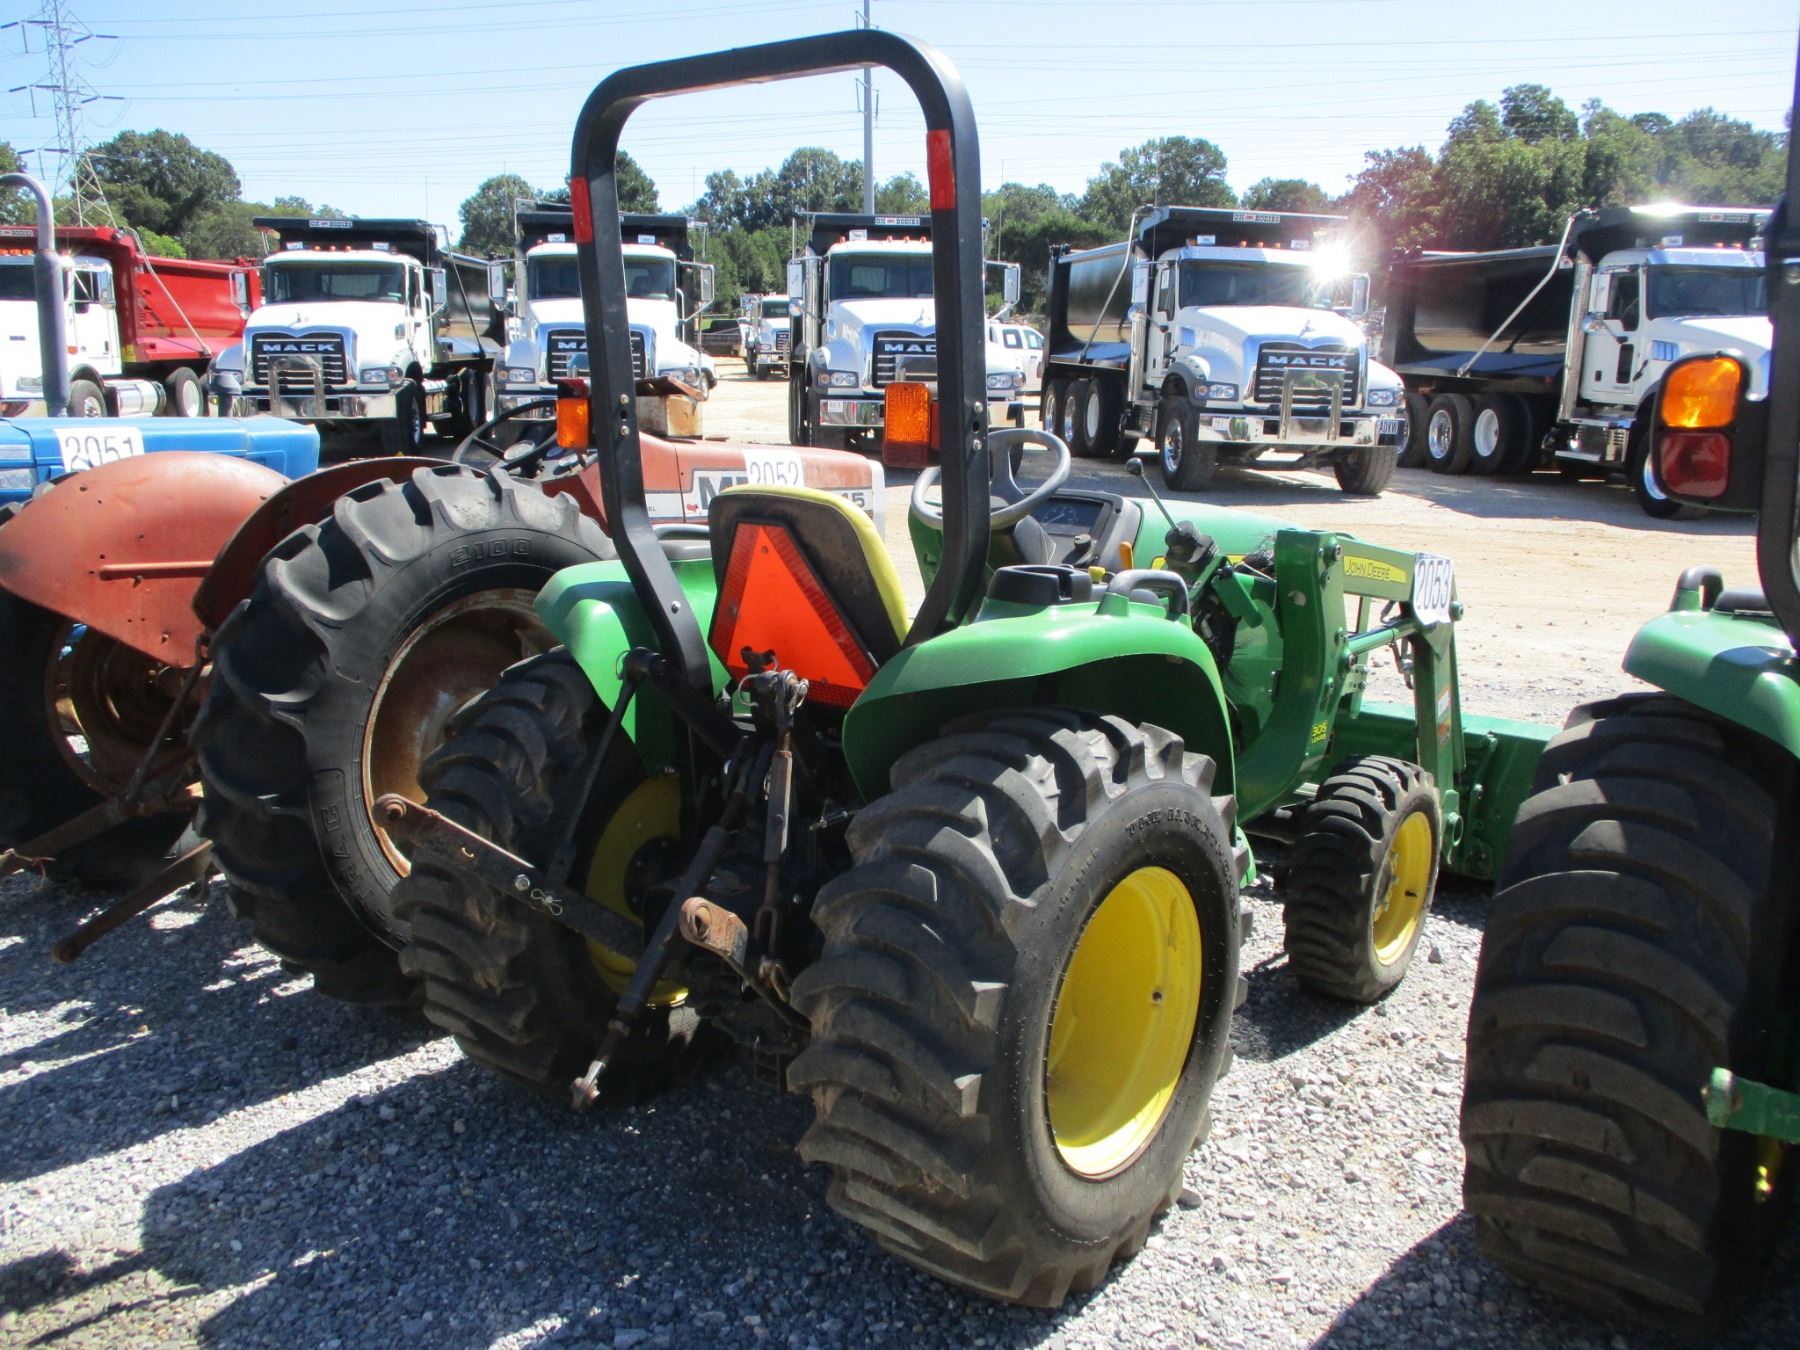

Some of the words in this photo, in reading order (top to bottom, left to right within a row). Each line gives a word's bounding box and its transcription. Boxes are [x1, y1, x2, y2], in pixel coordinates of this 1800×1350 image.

[262, 343, 335, 352] MACK
[884, 343, 937, 352] MAC
[1268, 355, 1347, 366] MACK
[64, 434, 136, 471] 2051
[749, 461, 799, 486] 2052
[449, 537, 532, 567] 2100
[1345, 559, 1367, 576] JOHN
[1367, 562, 1392, 580] DEERE
[1417, 559, 1451, 611] 2053
